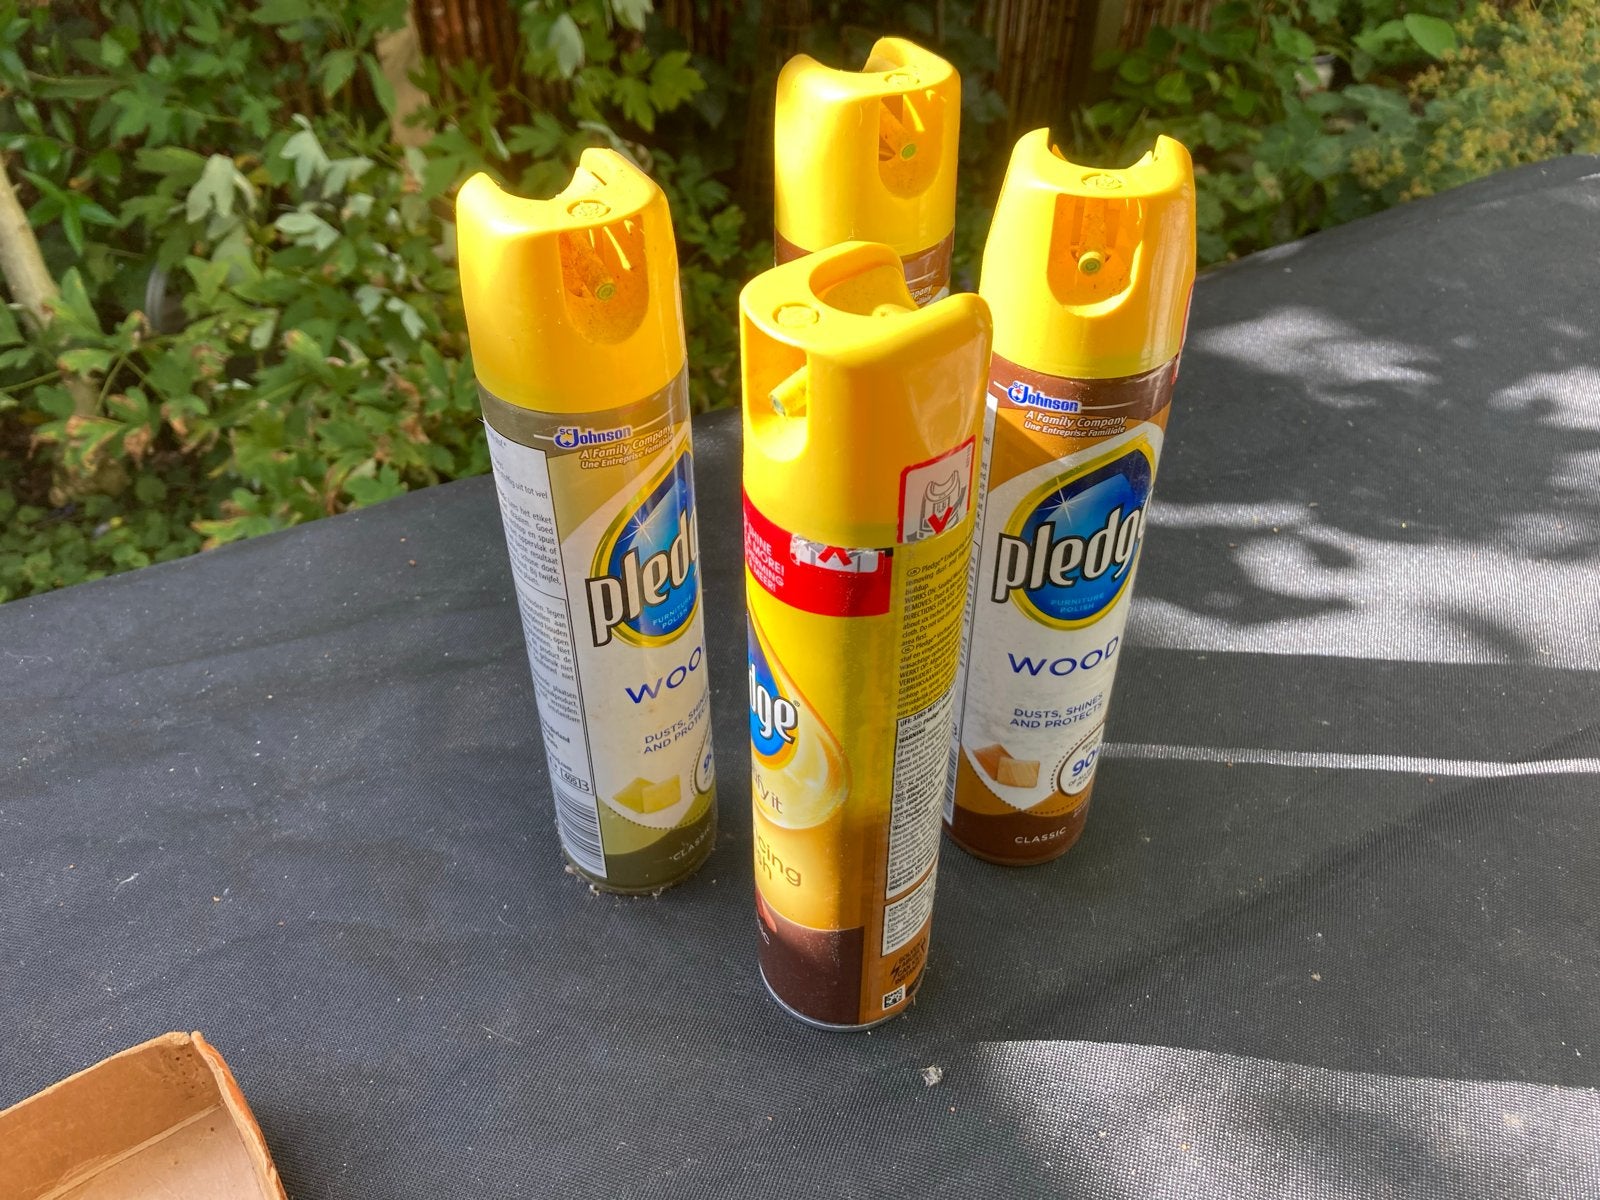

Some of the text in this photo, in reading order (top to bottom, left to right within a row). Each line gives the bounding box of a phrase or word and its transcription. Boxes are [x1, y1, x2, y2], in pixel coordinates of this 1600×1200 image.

[1008, 385, 1078, 412] Johnson
[1025, 410, 1127, 427] A Family Company
[1025, 421, 1126, 437] Une Entreprise Familiale
[555, 427, 632, 448] Johnson
[581, 424, 673, 459] A Family Company
[581, 460, 599, 469] Une
[601, 451, 643, 467] Entreprise
[991, 490, 1150, 603] pledg
[585, 505, 698, 647] pled
[1060, 603, 1095, 613] POLISH
[1008, 636, 1119, 676] WOOD
[625, 640, 705, 704] WOO
[1010, 701, 1104, 729] AND PROTECTS
[1014, 691, 1103, 719] DUSTS, SHINES
[645, 719, 686, 744] DUSTS,
[644, 737, 671, 755] AND
[1072, 747, 1100, 777] 90
[1015, 827, 1067, 844] CLASSIC
